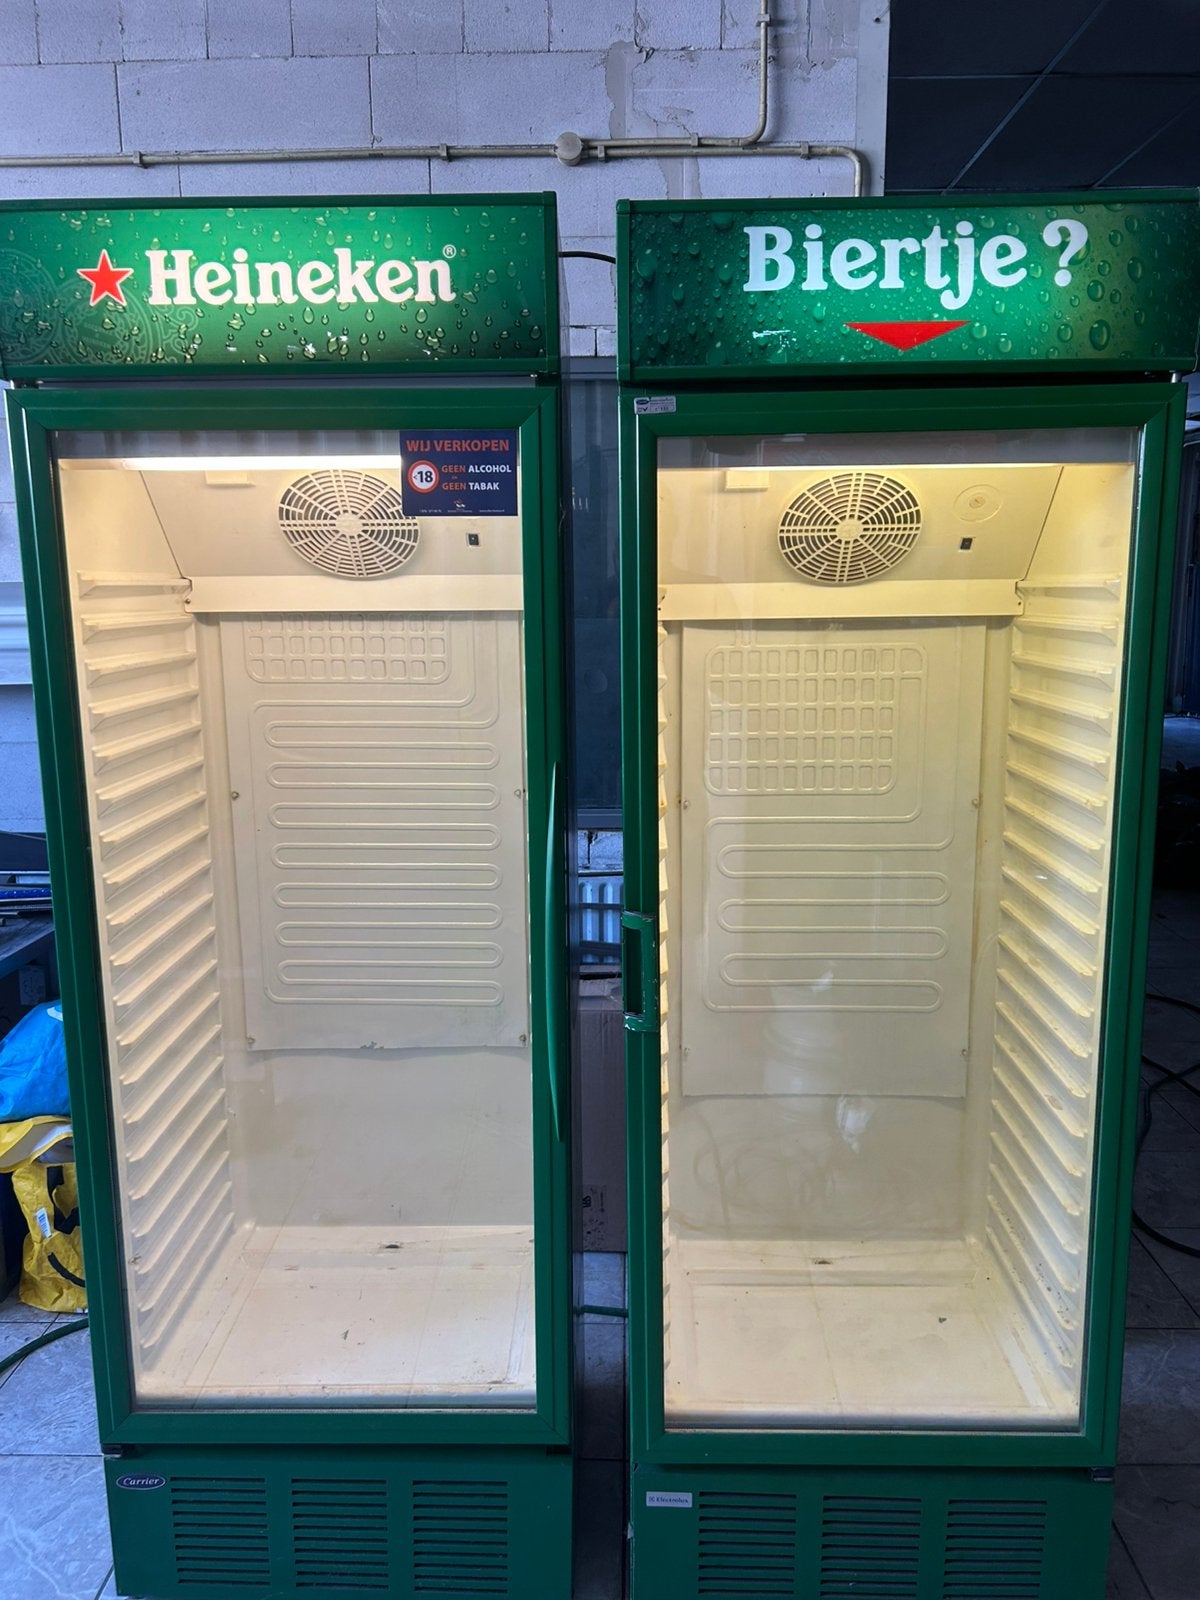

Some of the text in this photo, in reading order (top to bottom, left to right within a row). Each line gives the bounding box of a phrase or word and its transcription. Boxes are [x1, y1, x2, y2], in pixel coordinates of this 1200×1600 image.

[743, 218, 1089, 310] Biertje ?
[406, 439, 510, 452] WIJ VERKOPEN
[441, 464, 512, 473] GEEN ALCOHOL
[442, 482, 500, 490] GEEN TABAK
[122, 1477, 160, 1486] Carrier
